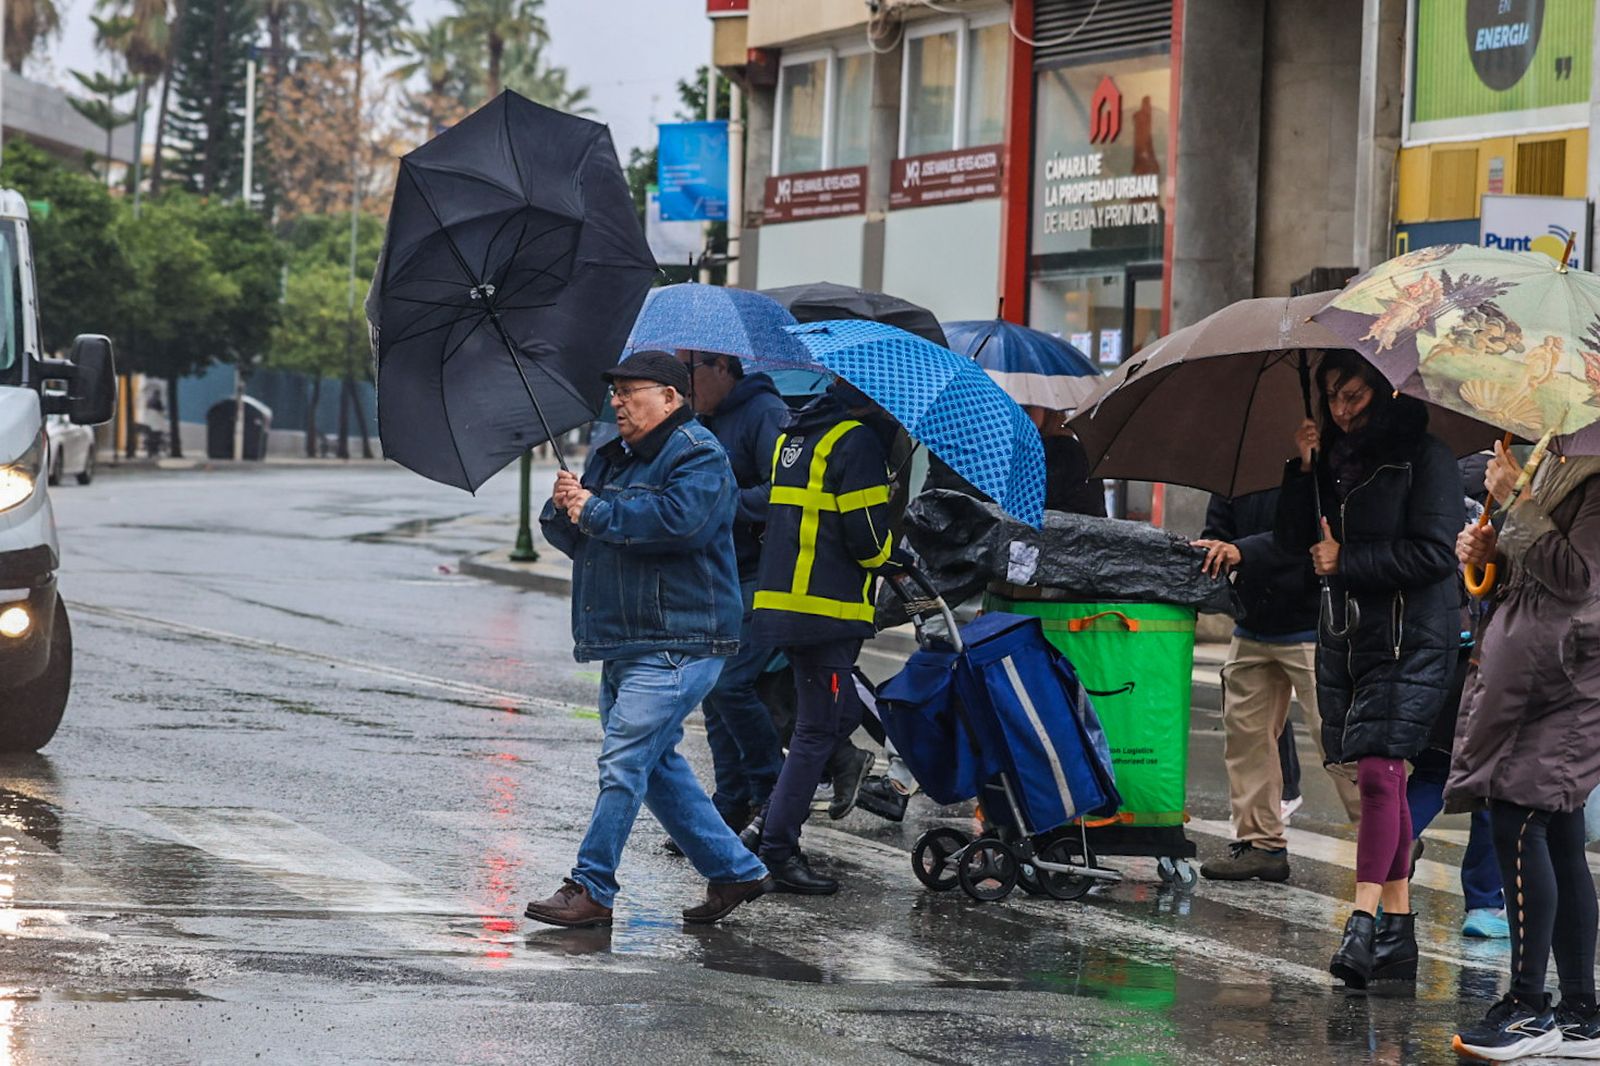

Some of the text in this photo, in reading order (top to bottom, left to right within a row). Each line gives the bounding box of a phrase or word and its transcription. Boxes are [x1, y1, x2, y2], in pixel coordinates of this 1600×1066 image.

[1045, 151, 1103, 180] CÁMARA DE
[1045, 174, 1159, 207] LA PROPIEDAD URBANA
[1044, 211, 1058, 234] DE
[1059, 207, 1097, 232] HUELVA
[1105, 202, 1158, 227] PROVNCIA
